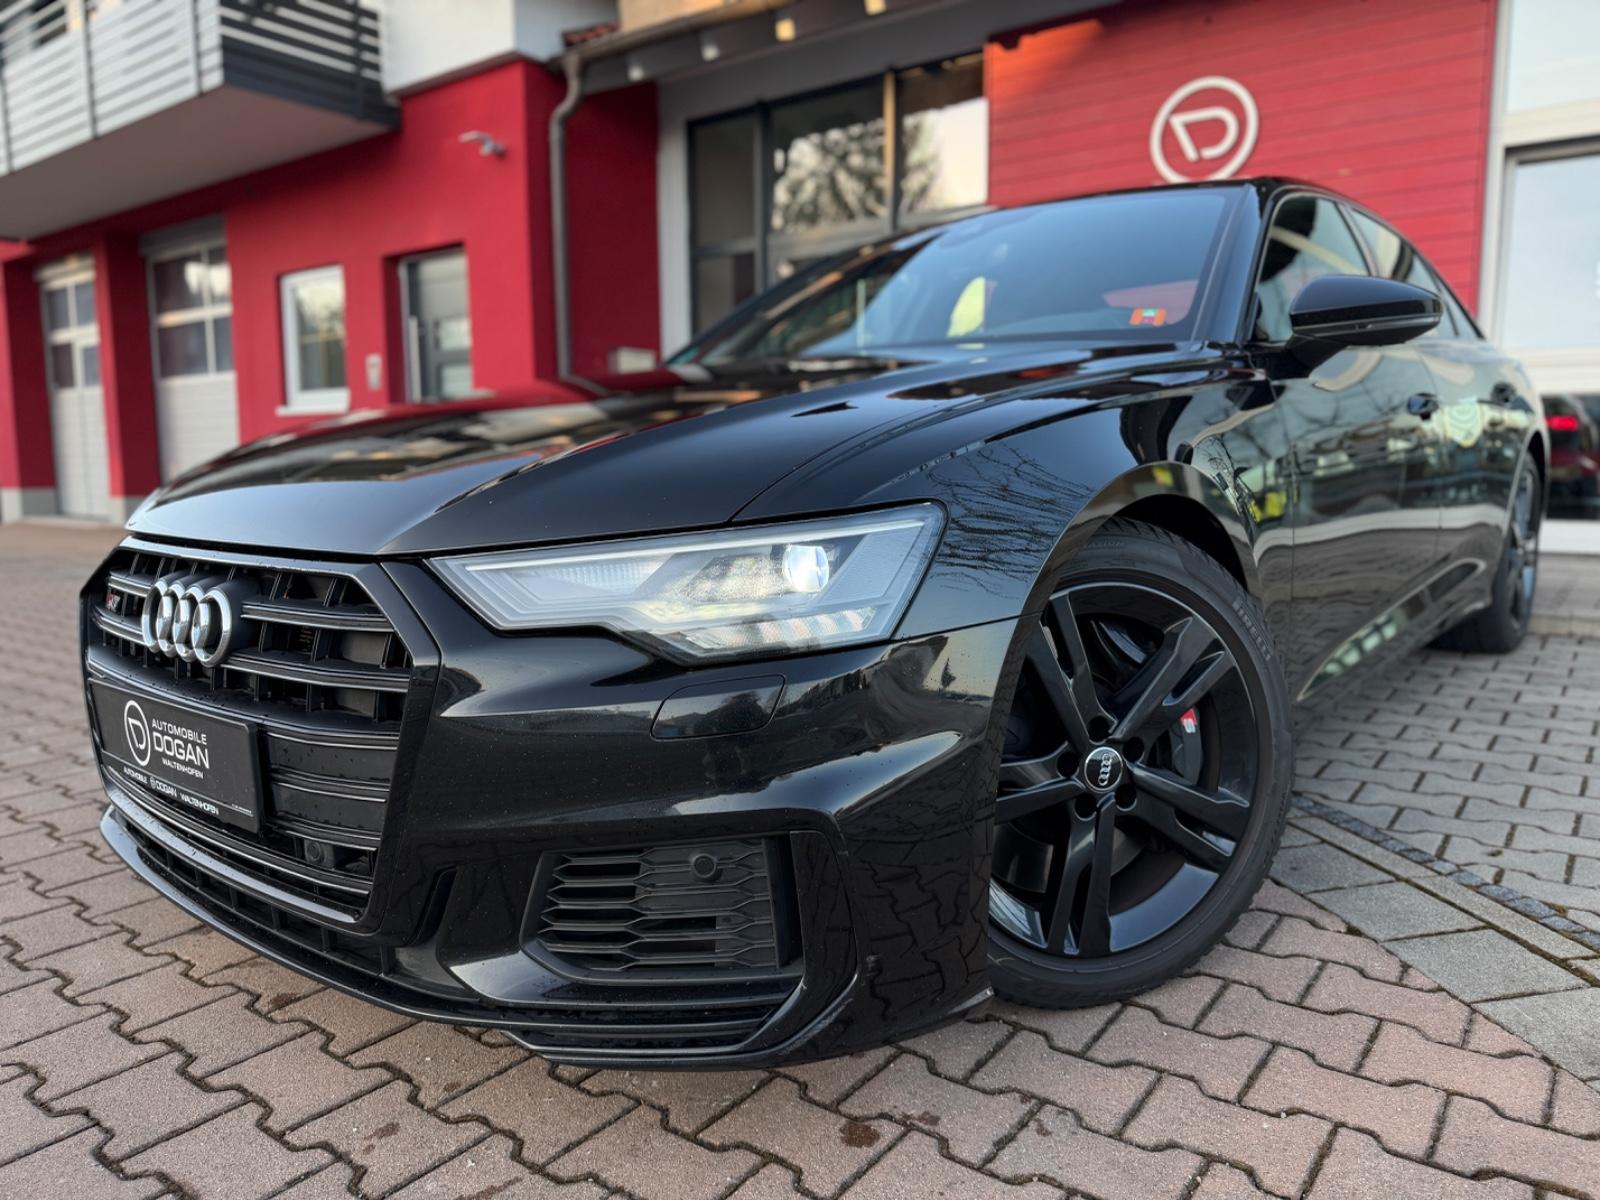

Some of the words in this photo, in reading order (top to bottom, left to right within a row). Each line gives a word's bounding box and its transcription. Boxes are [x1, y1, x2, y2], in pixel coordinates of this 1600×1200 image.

[151, 718, 207, 745] AUTOMOBILE
[152, 732, 210, 769] DOGAN
[162, 757, 204, 779] WALTENHOFEN
